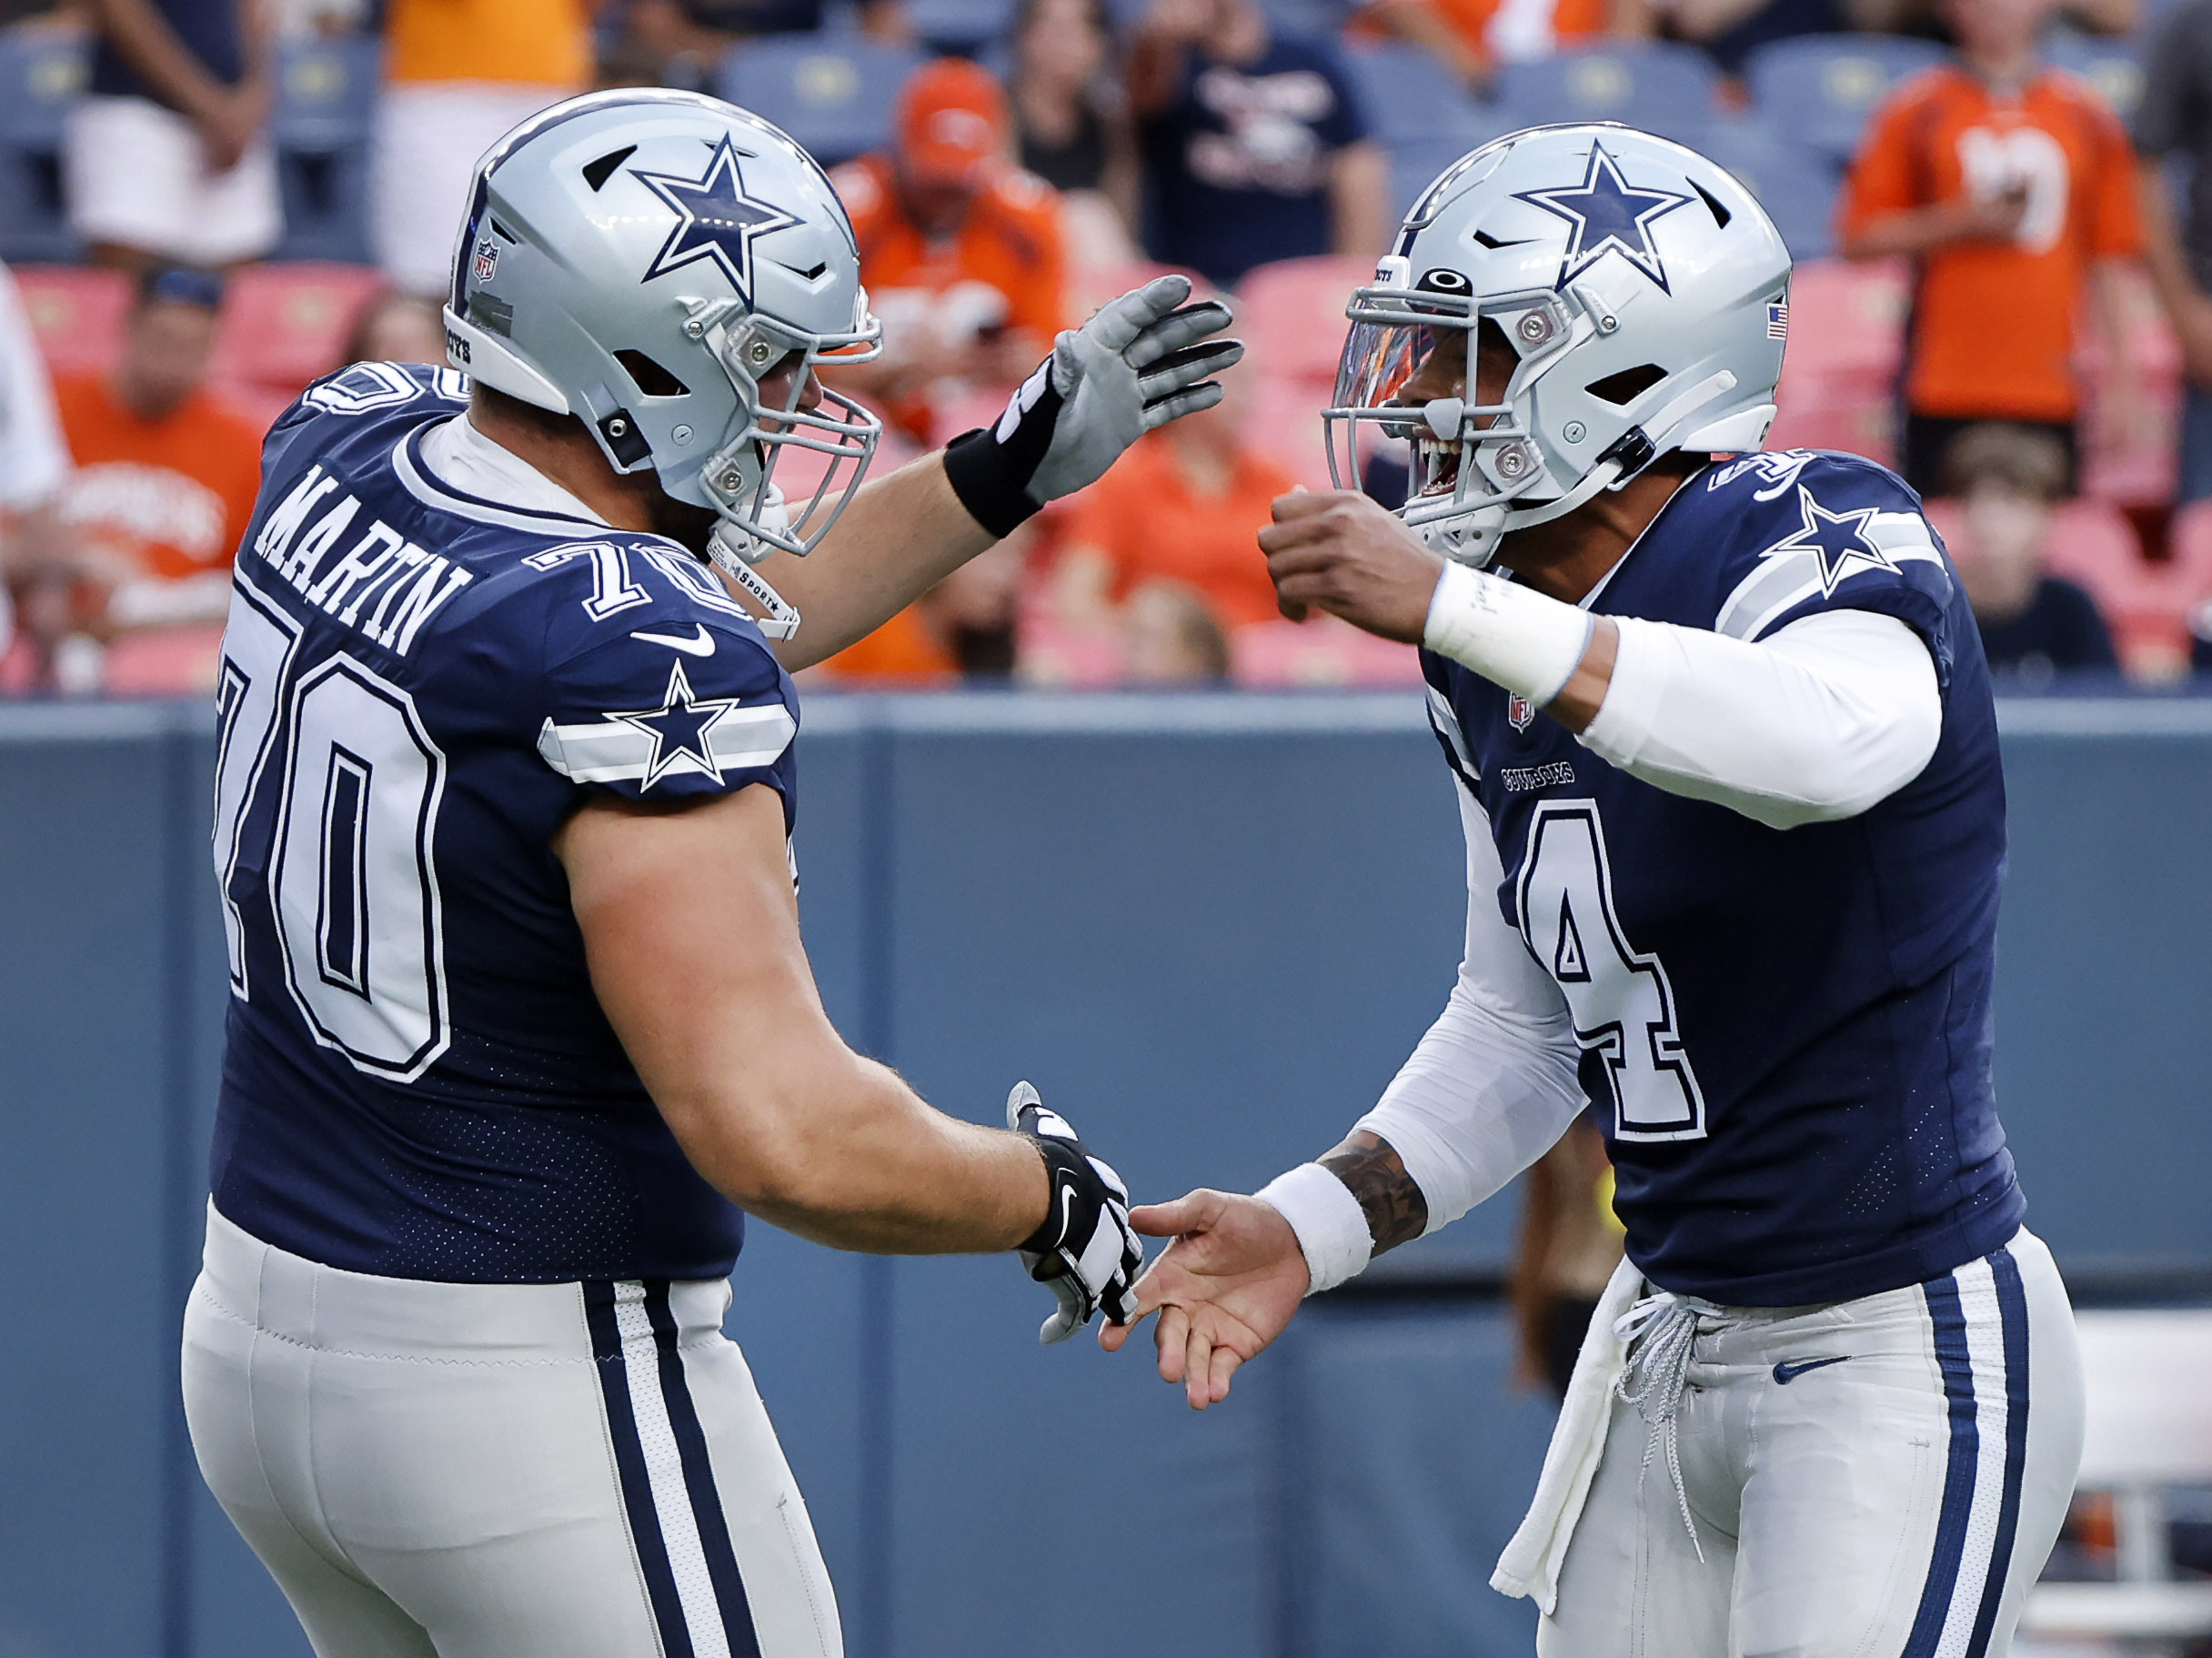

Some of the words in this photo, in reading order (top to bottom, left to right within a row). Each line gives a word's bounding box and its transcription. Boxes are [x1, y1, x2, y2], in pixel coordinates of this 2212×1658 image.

[476, 255, 493, 276] NFL
[254, 464, 474, 657] MARTIN
[521, 540, 754, 622] 70
[212, 557, 451, 1084] 70
[1502, 762, 1575, 791] COWBOYS
[1516, 798, 1707, 1142] 4
